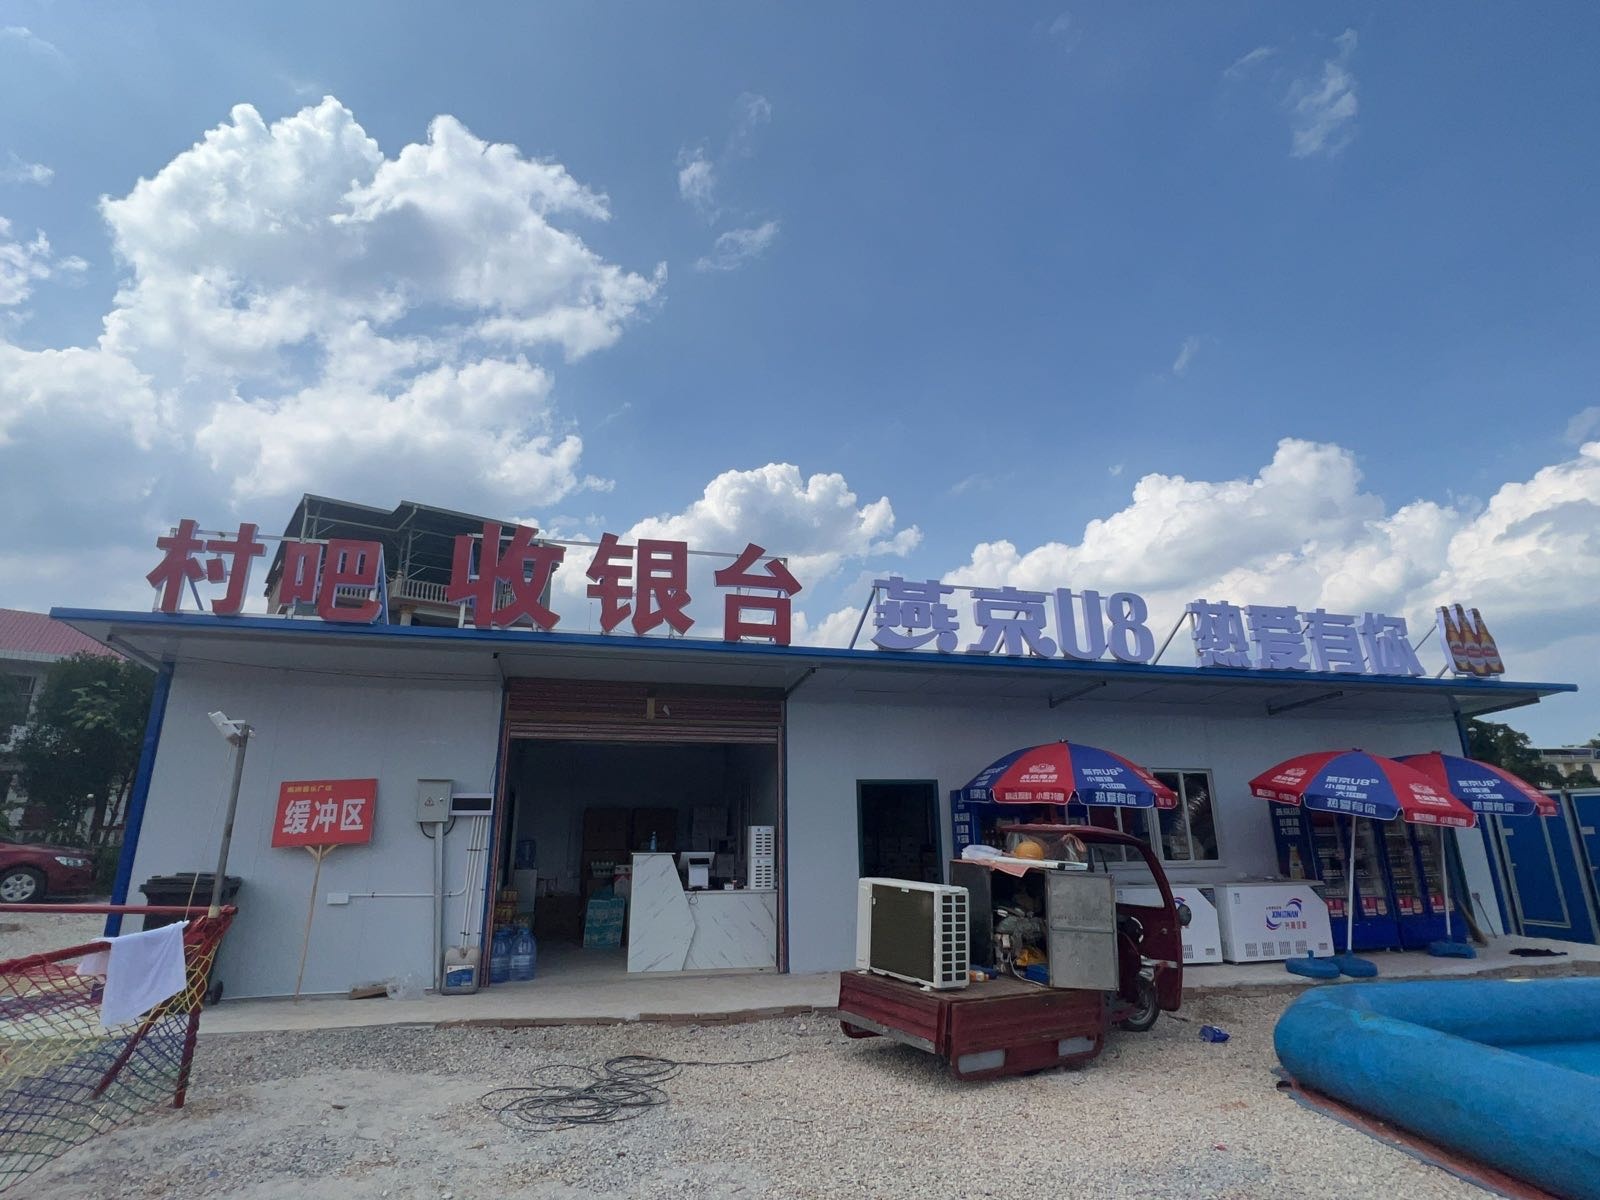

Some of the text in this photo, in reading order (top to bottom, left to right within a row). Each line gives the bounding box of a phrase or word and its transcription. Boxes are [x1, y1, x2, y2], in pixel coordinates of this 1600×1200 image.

[147, 519, 803, 646] 村吧收银台
[870, 576, 1426, 676] 燕京U8 热爱有你
[282, 798, 366, 834] 缓冲区
[1095, 791, 1136, 805] 热爱有你
[1327, 798, 1376, 814] 热爱有你
